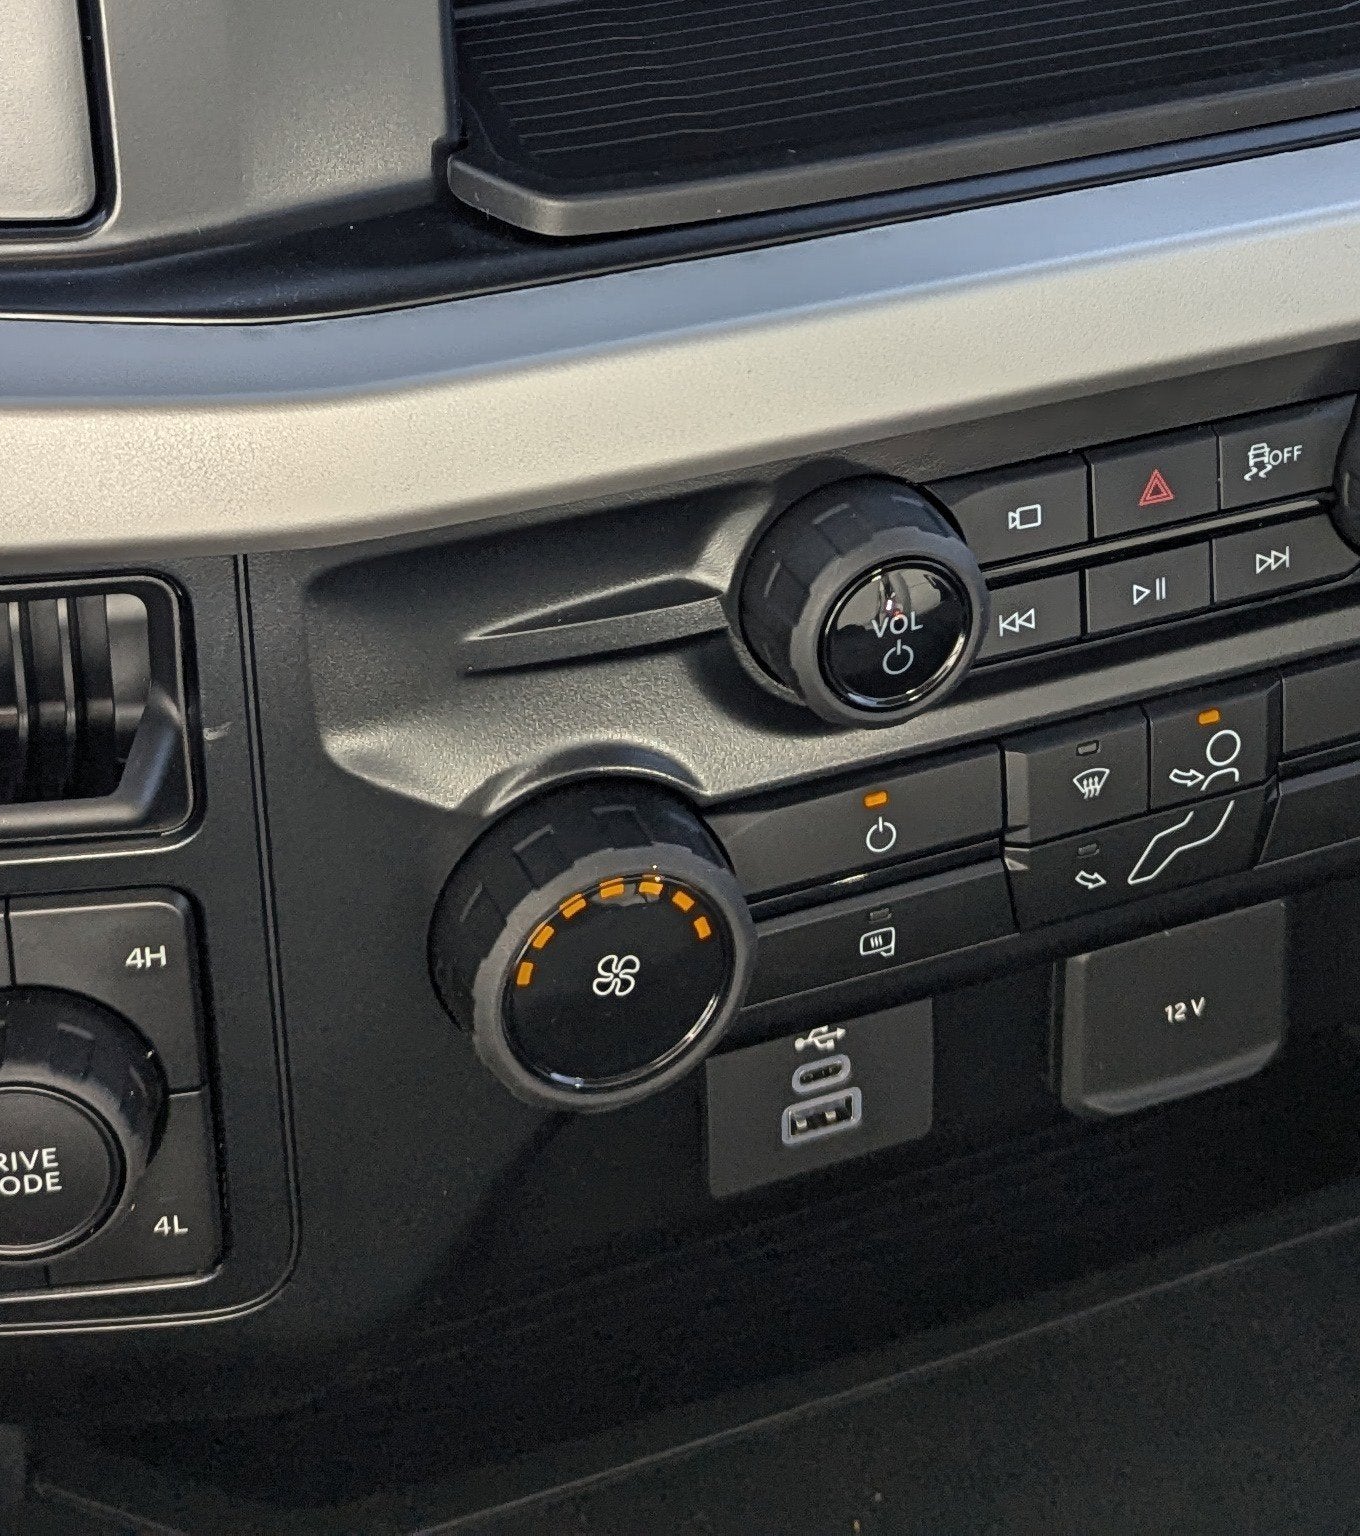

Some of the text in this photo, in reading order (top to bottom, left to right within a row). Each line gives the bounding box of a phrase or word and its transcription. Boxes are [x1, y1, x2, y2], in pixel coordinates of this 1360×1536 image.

[1268, 444, 1303, 466] OFF
[872, 613, 924, 638] VOL
[125, 945, 167, 969] 4H
[153, 1215, 189, 1237] 4L
